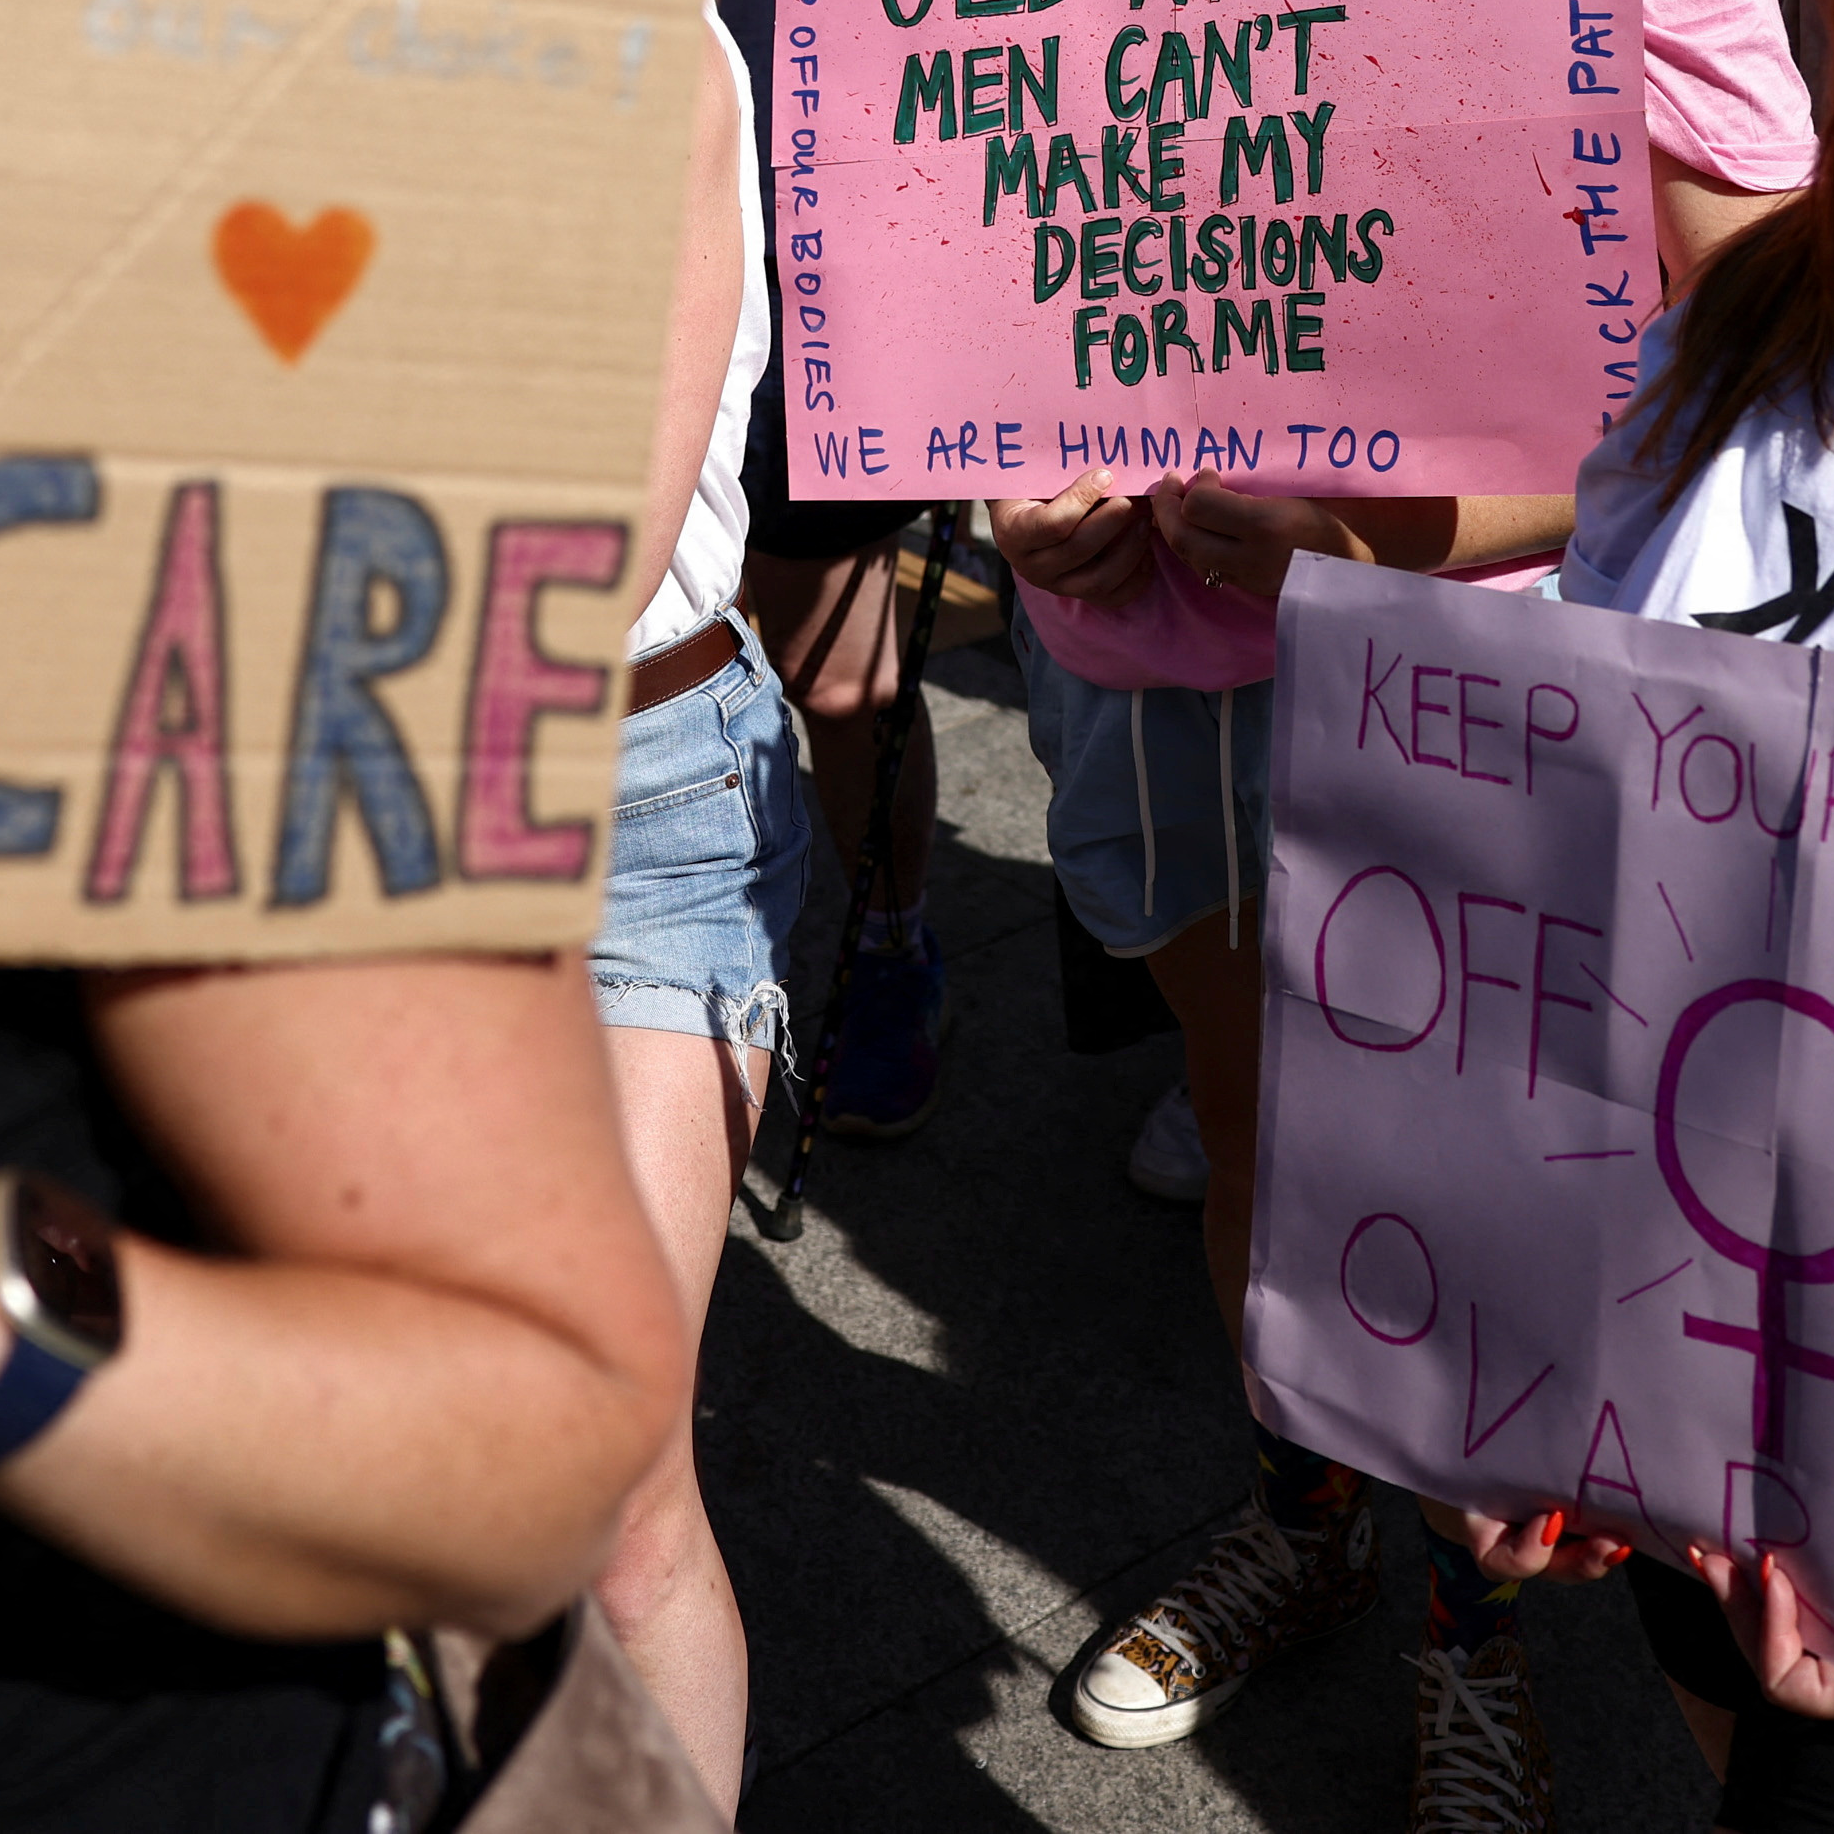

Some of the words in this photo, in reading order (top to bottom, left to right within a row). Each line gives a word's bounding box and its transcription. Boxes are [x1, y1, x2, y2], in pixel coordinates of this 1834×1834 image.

[789, 26, 820, 118] OFF
[893, 36, 1059, 144] MEN
[1105, 5, 1347, 126] CAN'T
[790, 129, 819, 217] OUR
[983, 122, 1185, 226] MAKE
[1219, 102, 1336, 207] MY
[1573, 128, 1628, 256] THE
[1033, 208, 1394, 304] DECISIONS
[790, 229, 835, 413] BODIES
[1074, 300, 1203, 388] FOR
[1214, 292, 1327, 374] ME
[1586, 270, 1637, 437] UCK
[814, 427, 890, 479] WE
[926, 421, 1025, 471] ARE
[1060, 422, 1263, 470] HUMAN
[1288, 427, 1400, 473] TOO
[1359, 638, 1579, 796] KEEP
[1314, 865, 1603, 1098] OFF
